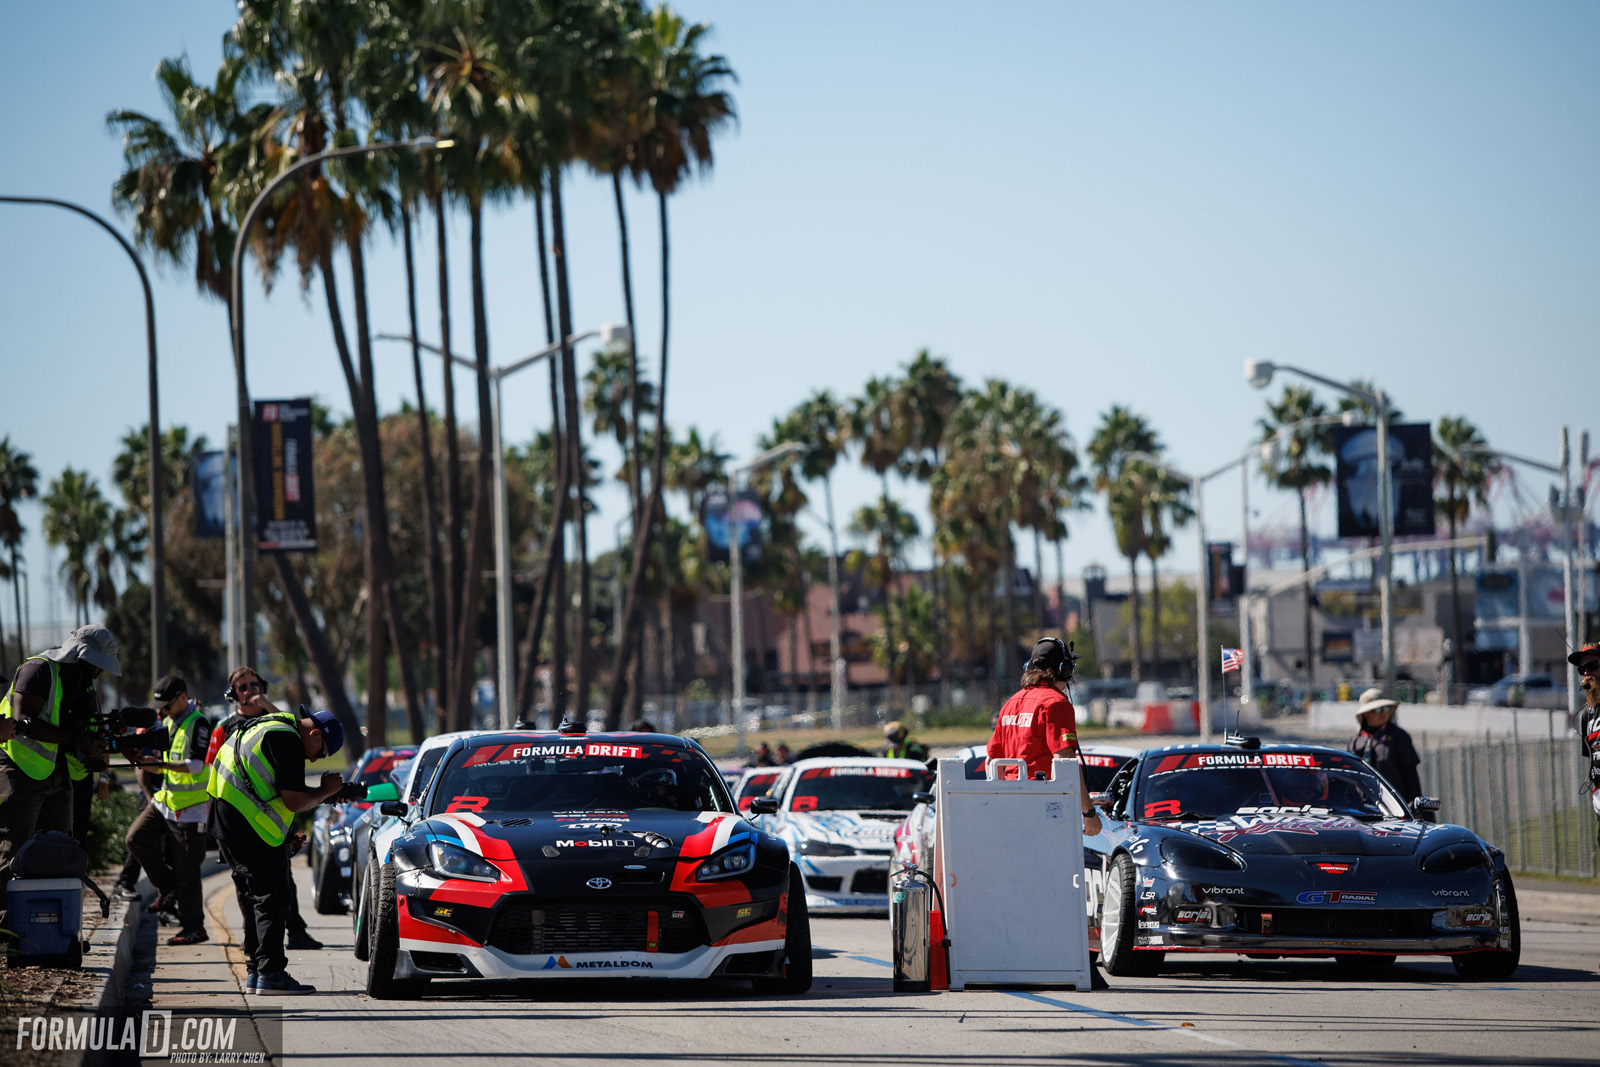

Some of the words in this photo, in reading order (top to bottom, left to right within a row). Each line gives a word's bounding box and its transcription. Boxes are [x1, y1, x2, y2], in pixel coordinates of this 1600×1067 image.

[513, 745, 584, 758] FORMULA
[588, 744, 640, 758] DRIFT
[1198, 755, 1262, 766] FORMULA
[1265, 754, 1312, 766] DRIFT
[830, 767, 874, 777] FORMULA
[875, 767, 908, 778] DRIFT
[1144, 800, 1181, 818] R
[556, 839, 613, 848] Mobil
[1202, 886, 1245, 895] vibrant
[1431, 889, 1470, 897] vibrant
[1296, 891, 1341, 904] GT
[575, 961, 654, 969] METALDOM
